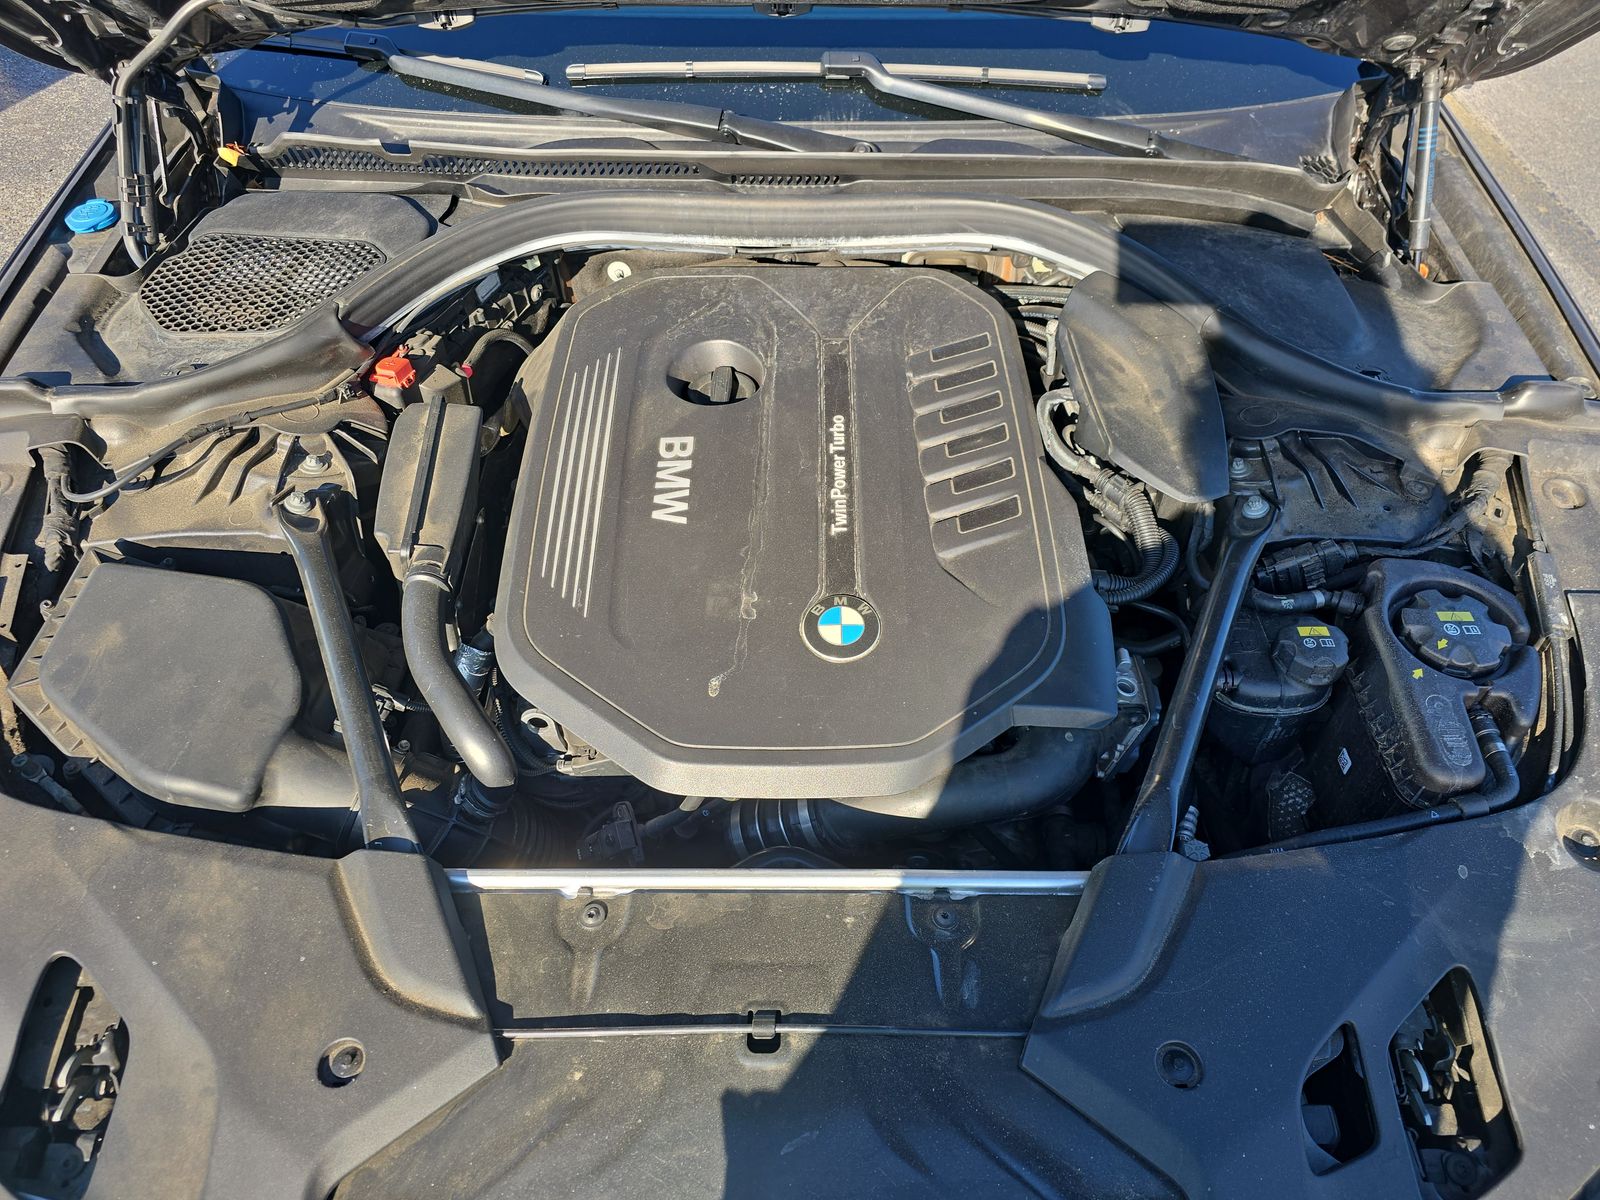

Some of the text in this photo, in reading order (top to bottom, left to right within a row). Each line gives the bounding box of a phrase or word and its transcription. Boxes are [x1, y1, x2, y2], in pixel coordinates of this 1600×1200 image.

[651, 436, 694, 524] BMW
[829, 414, 848, 536] TwinPower Turbo
[810, 596, 872, 616] BMW
